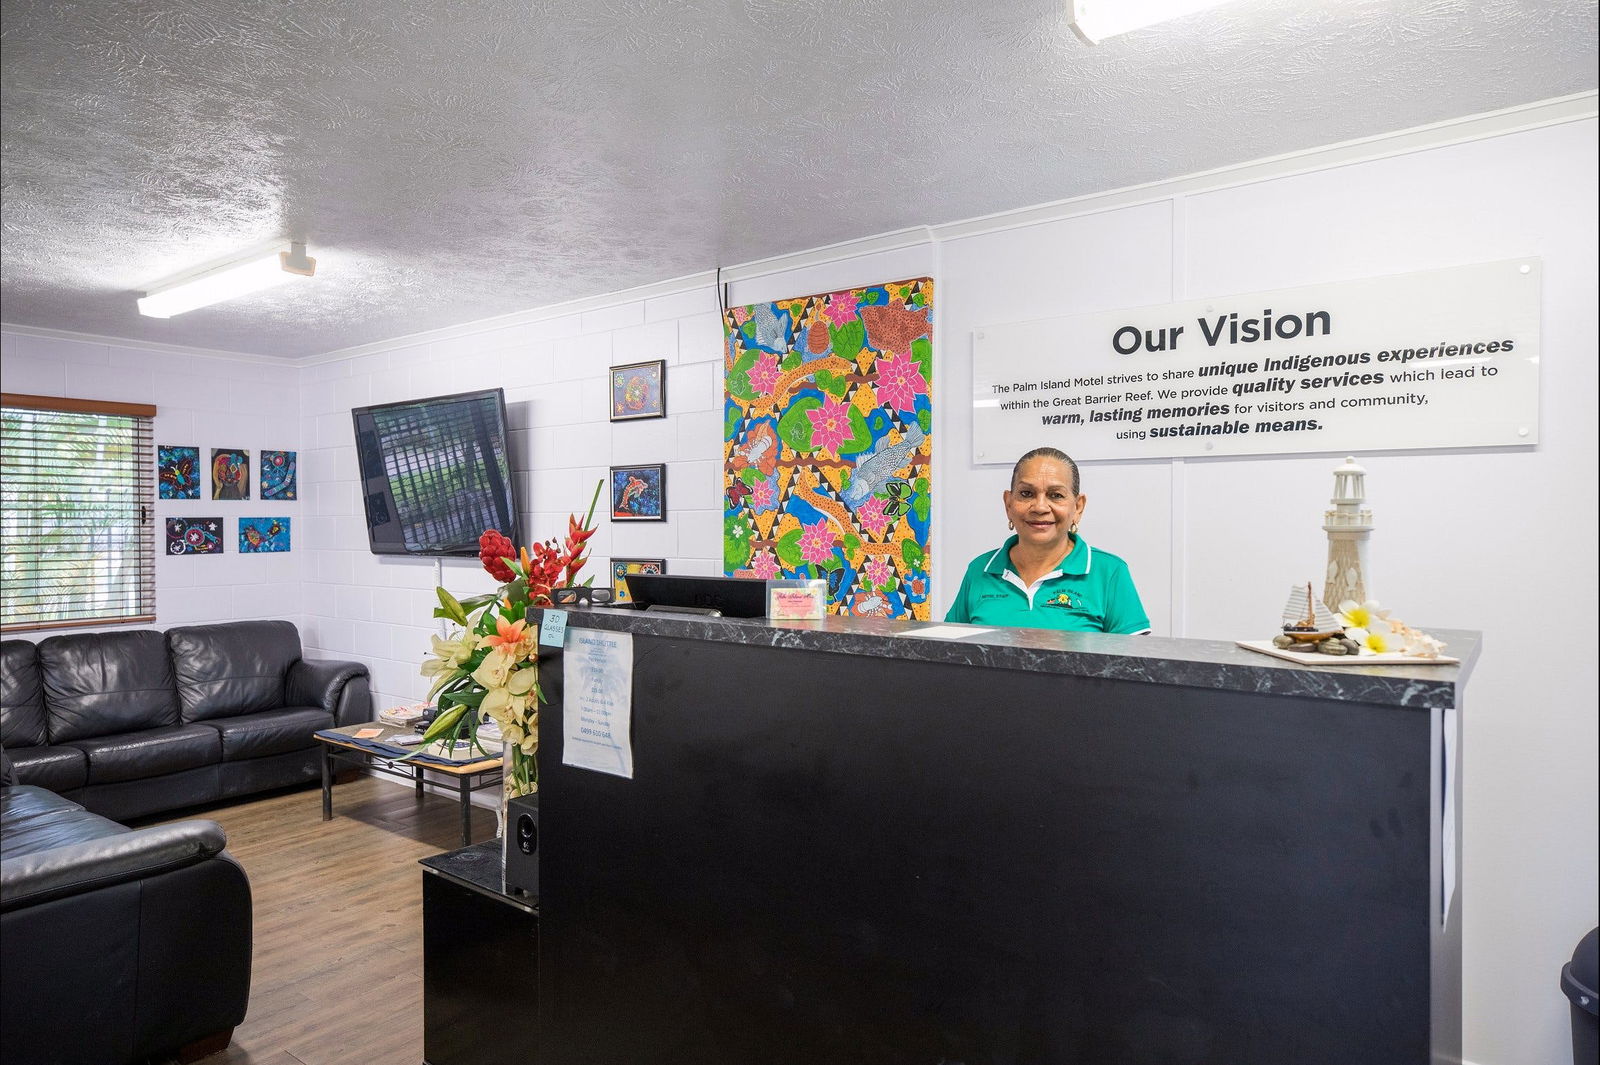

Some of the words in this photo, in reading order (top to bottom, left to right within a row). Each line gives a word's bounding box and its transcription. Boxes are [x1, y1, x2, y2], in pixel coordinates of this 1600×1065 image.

[1112, 325, 1185, 356] Our
[1196, 308, 1331, 347] Vision
[991, 383, 1011, 394] The
[1012, 382, 1038, 393] Palm
[1040, 378, 1071, 391] Island
[1073, 376, 1104, 388] Motel
[1106, 374, 1144, 386] strives
[1146, 372, 1159, 382] to
[1161, 369, 1195, 381] share
[1197, 361, 1259, 379] unique
[1263, 352, 1371, 374] Indigenous
[1376, 339, 1514, 365] experiences
[1000, 399, 1030, 411] within
[1032, 398, 1050, 410] the
[1052, 396, 1082, 408] Great
[1084, 393, 1122, 406] Barrier
[1125, 391, 1155, 403] Reef.
[1157, 389, 1178, 400] We
[1180, 386, 1229, 401] provide
[1231, 376, 1296, 398] quality
[1299, 371, 1384, 391] services
[1389, 370, 1435, 384] which
[1440, 365, 1475, 380] lead
[1480, 366, 1499, 377] to
[1041, 413, 1086, 427] warm,
[1088, 407, 1144, 424] lasting
[1146, 401, 1230, 421] memories
[1234, 403, 1253, 415] for
[1256, 400, 1305, 414] visitors
[1308, 397, 1336, 411] and
[1340, 393, 1430, 409] community,
[1115, 429, 1147, 441] using
[1148, 420, 1251, 440] sustainable
[1254, 419, 1324, 434] means.
[543, 623, 564, 634] GLASSES
[549, 614, 560, 623] 3D
